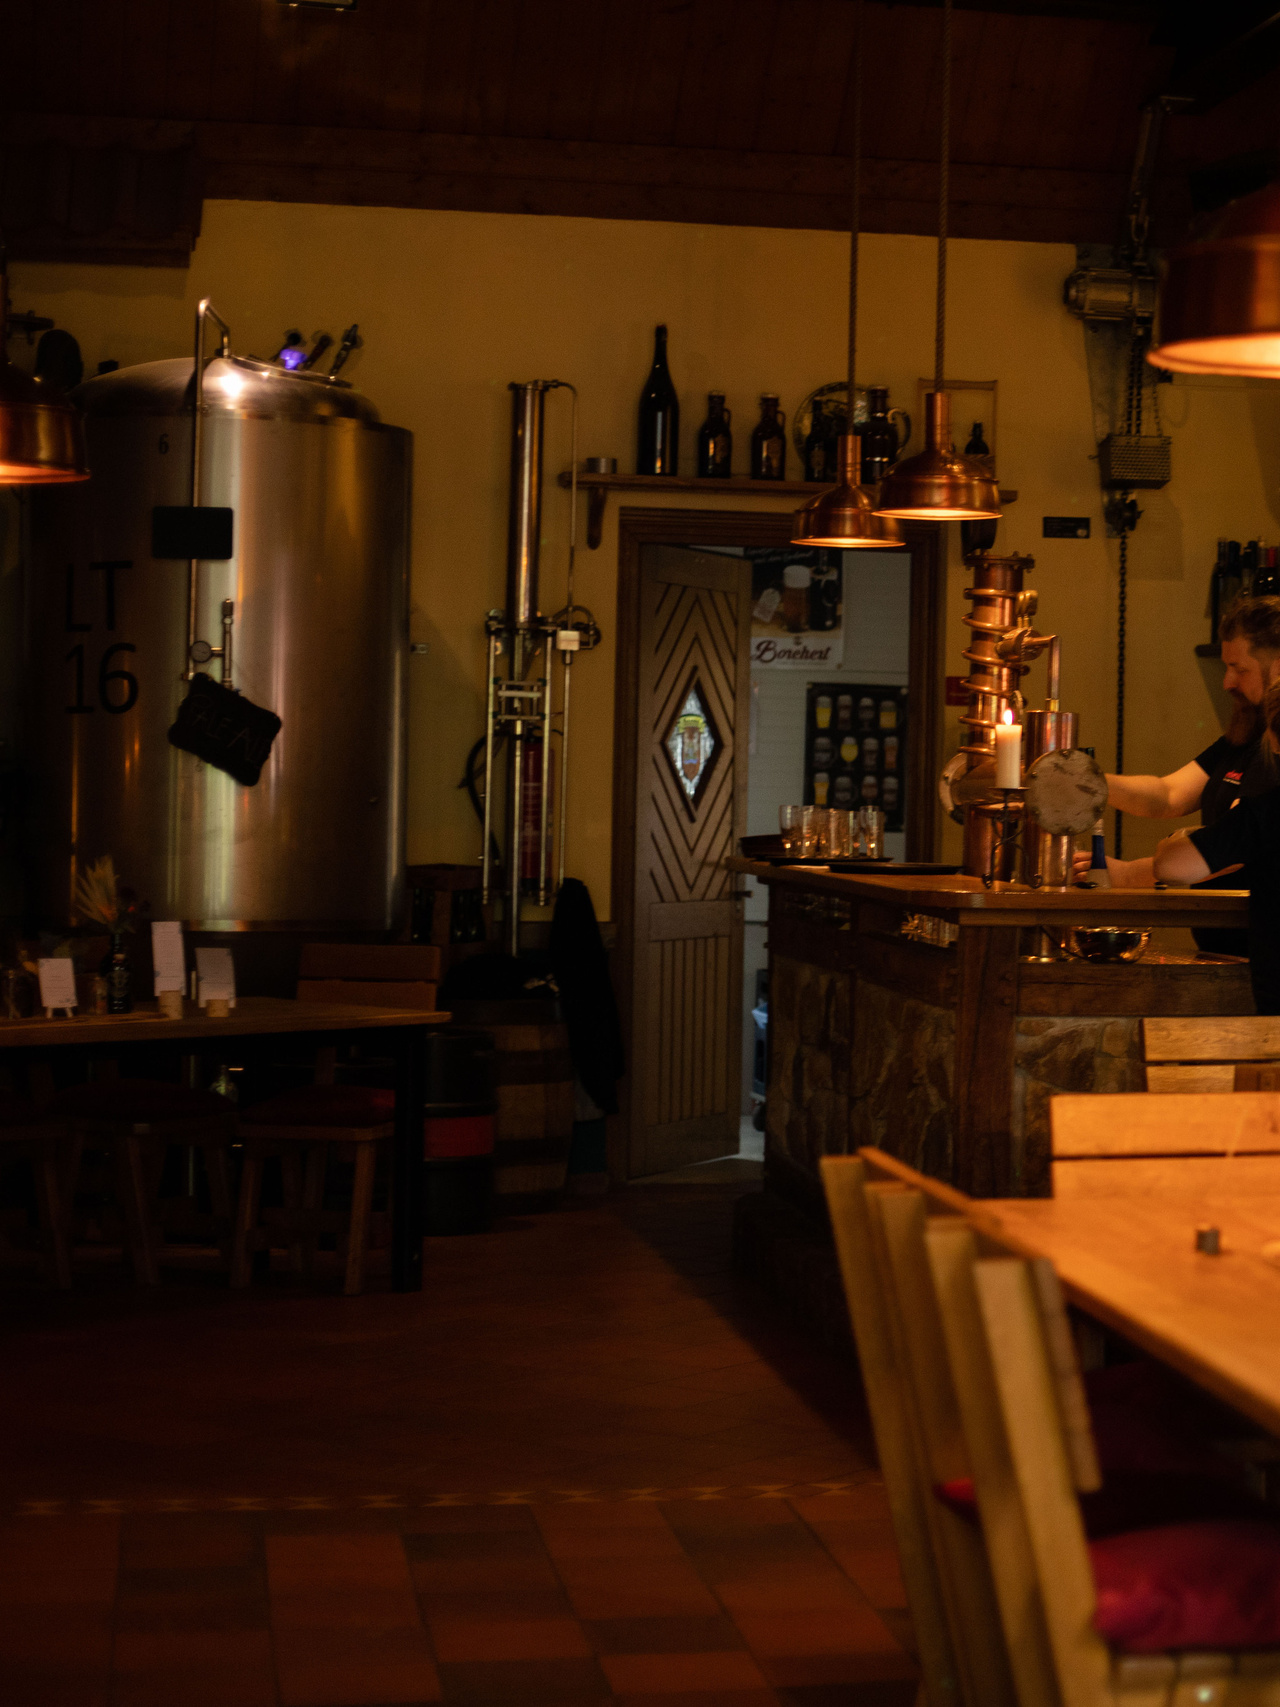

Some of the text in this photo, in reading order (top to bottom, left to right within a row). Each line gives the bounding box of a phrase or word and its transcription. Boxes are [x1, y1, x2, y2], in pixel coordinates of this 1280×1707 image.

[158, 432, 170, 455] 6
[65, 560, 133, 632] LT
[65, 643, 139, 714] 16
